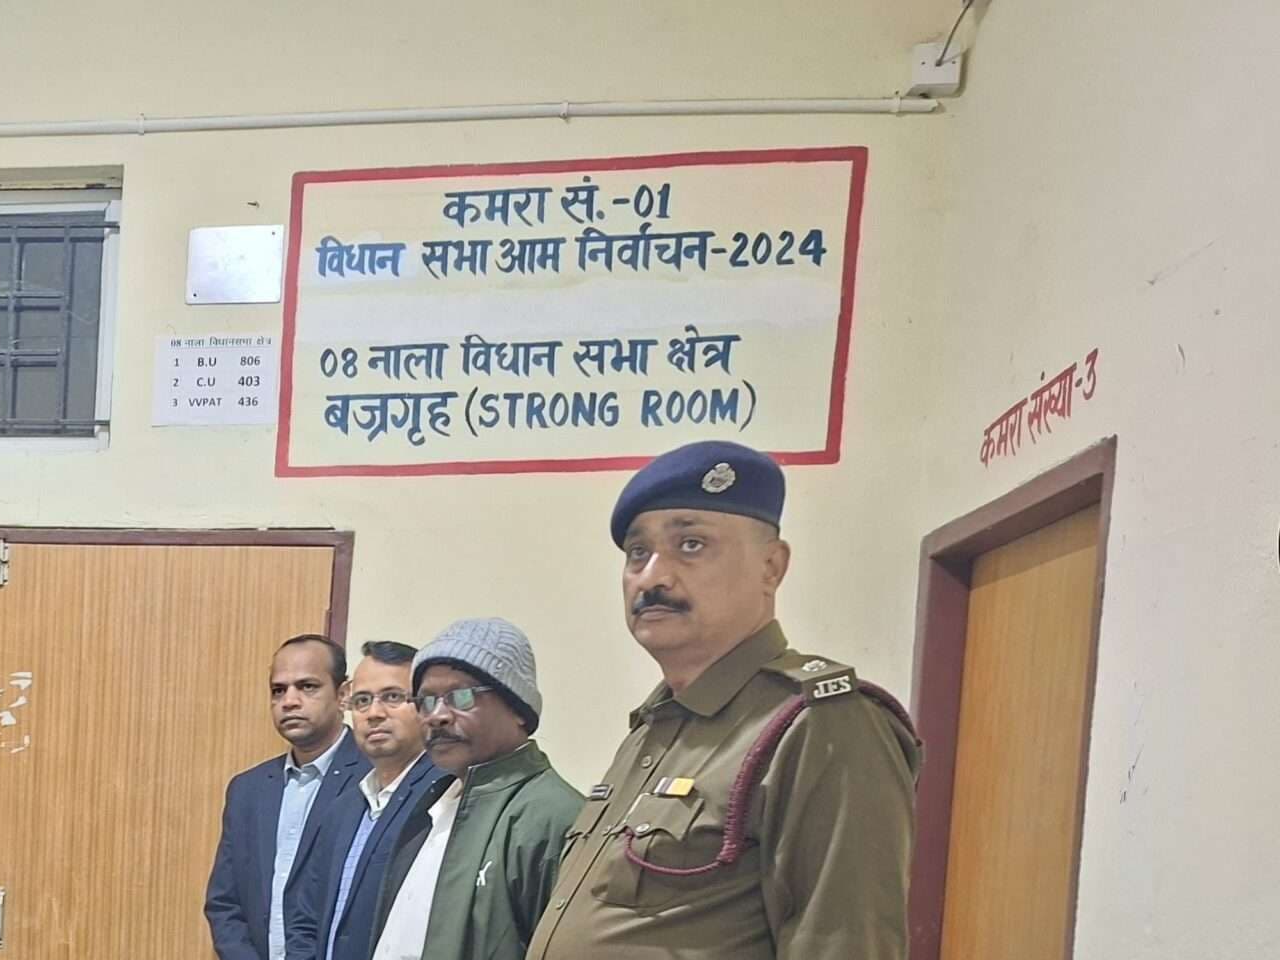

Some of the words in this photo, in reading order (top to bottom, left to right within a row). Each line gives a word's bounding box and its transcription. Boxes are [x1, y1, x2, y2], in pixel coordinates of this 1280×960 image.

[442, 187, 553, 228] कमरा
[315, 236, 407, 278] विधान
[422, 239, 493, 280] सभा
[495, 237, 567, 274] आम
[174, 358, 179, 367] 1
[197, 357, 217, 367] B.U
[240, 356, 261, 366] 806
[320, 348, 358, 378] 08
[368, 343, 450, 380] नाला
[461, 334, 563, 377] विधान
[573, 338, 658, 378] सभा
[667, 324, 742, 376] क्षेत्र
[172, 398, 178, 407] 3
[188, 398, 222, 407] VVPAT
[238, 397, 258, 407] 436
[173, 378, 179, 387] 2
[196, 377, 216, 387] C.U
[238, 376, 260, 387] 403
[465, 386, 619, 437] (STRONG
[640, 379, 756, 432] ROOM)
[980, 397, 1028, 468] कमरा
